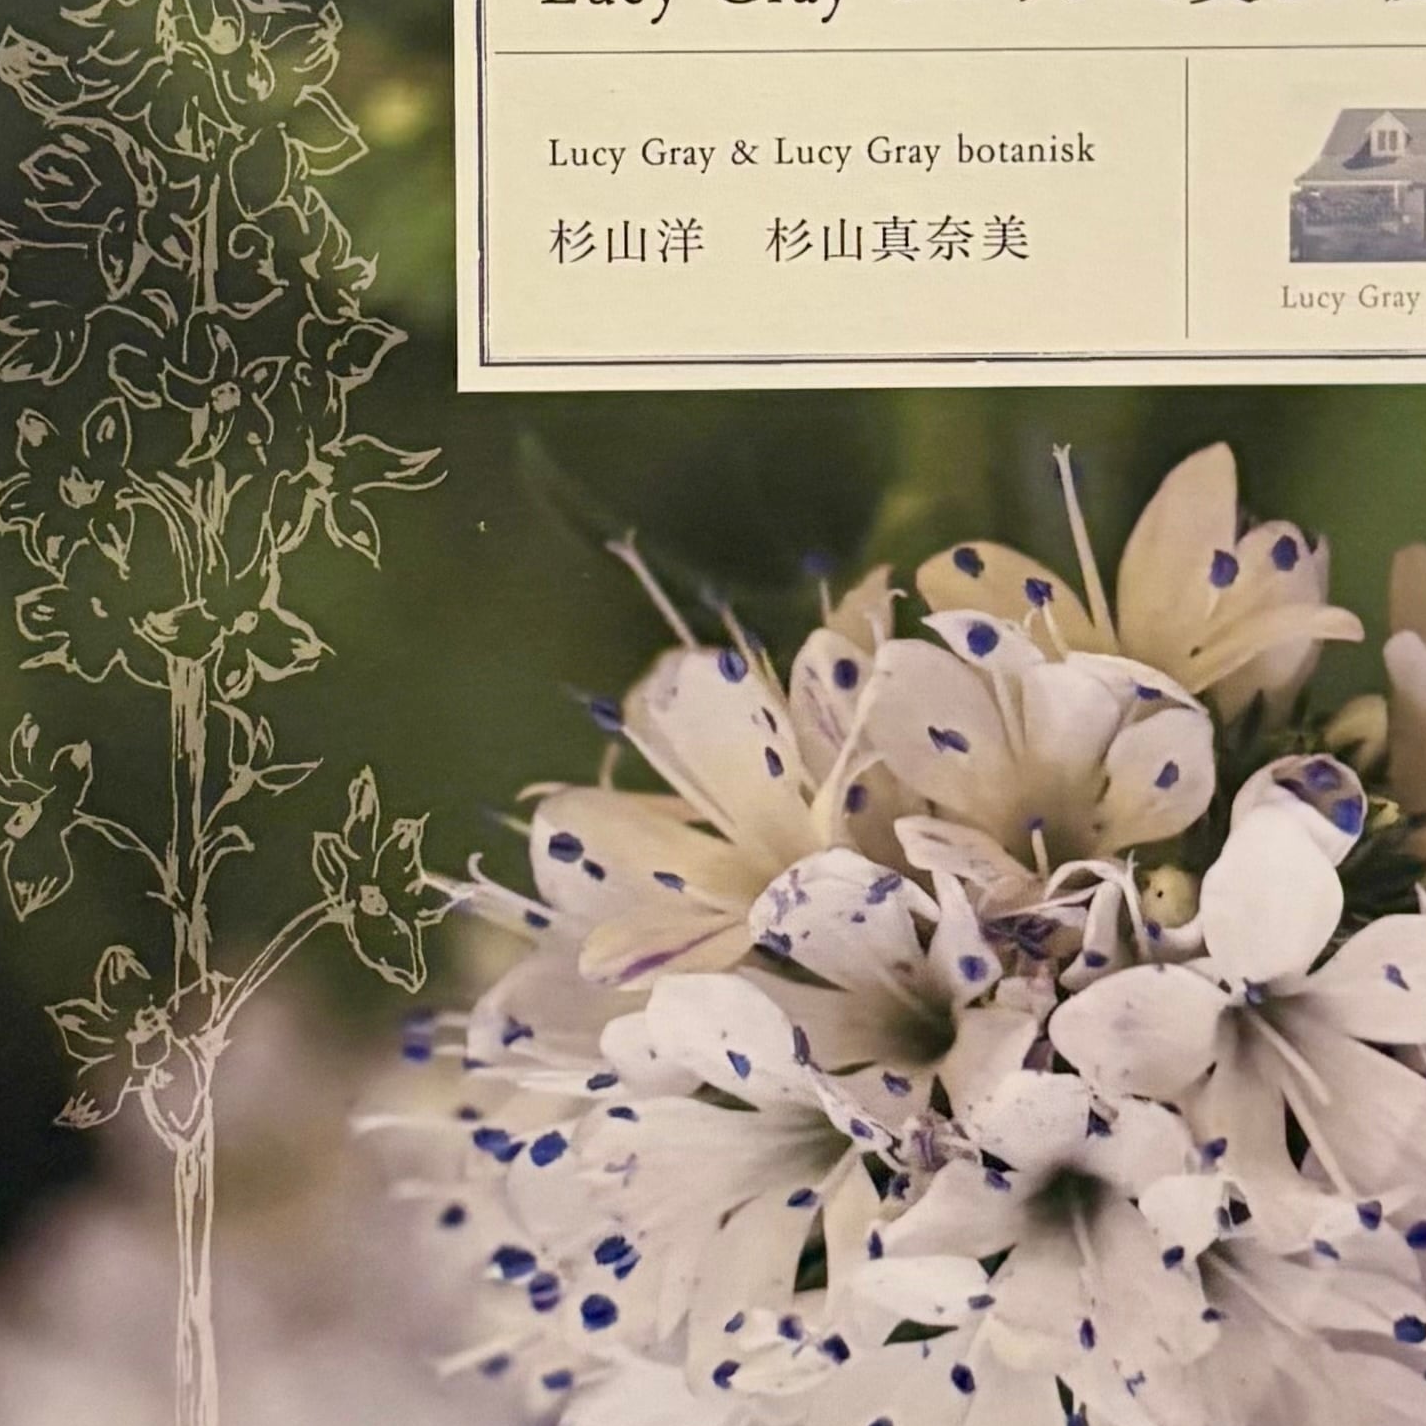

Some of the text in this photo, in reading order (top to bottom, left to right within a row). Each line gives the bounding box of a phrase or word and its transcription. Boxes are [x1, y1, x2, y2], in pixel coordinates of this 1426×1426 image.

[548, 131, 1096, 175] Lucy Gray & Lucy Gray botanisk
[548, 213, 1031, 265] 杉山洋 杉山真奈美
[1280, 284, 1347, 316] Lucy
[1357, 283, 1421, 316] Gray
